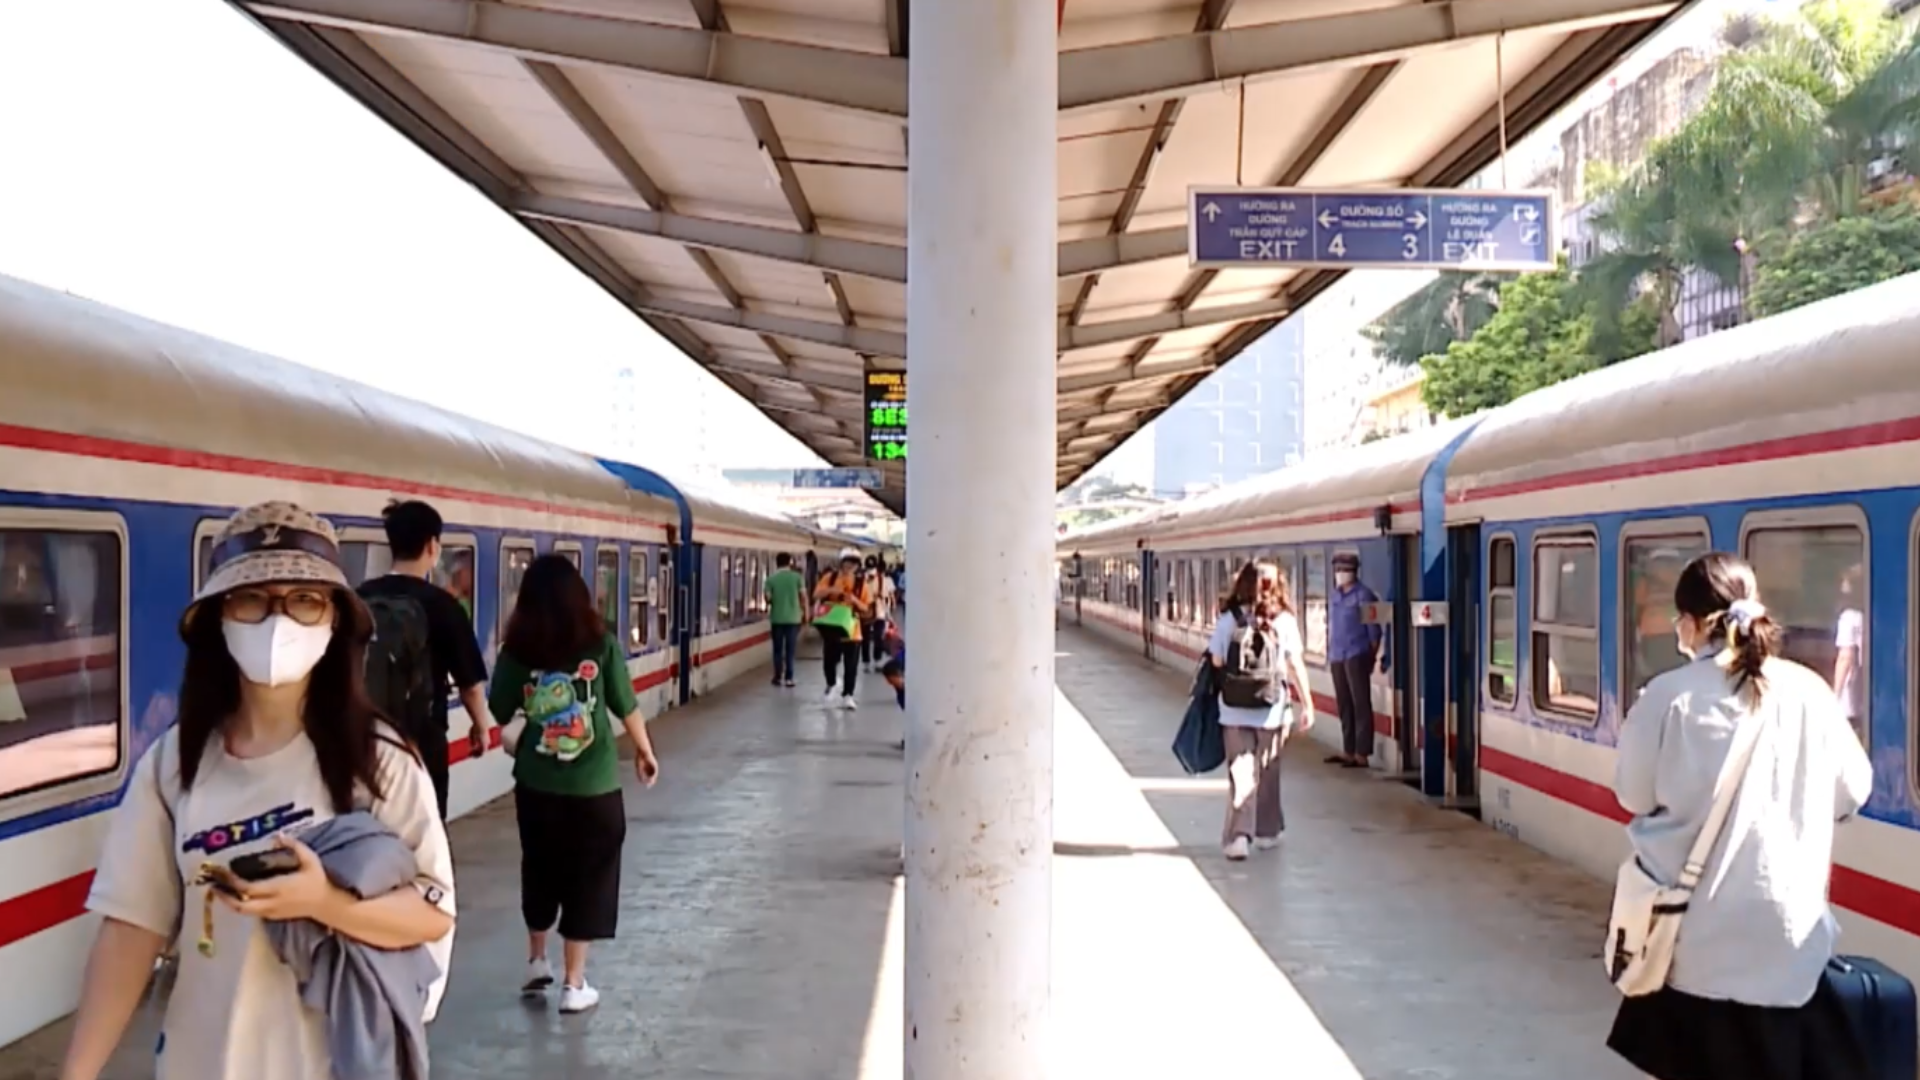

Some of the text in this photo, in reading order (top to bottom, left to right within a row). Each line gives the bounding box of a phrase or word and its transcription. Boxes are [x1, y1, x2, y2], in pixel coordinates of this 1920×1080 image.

[1240, 240, 1298, 258] EXIT
[1328, 233, 1418, 259] 4 3
[1443, 241, 1499, 261] EXIT
[1421, 605, 1431, 620] 4
